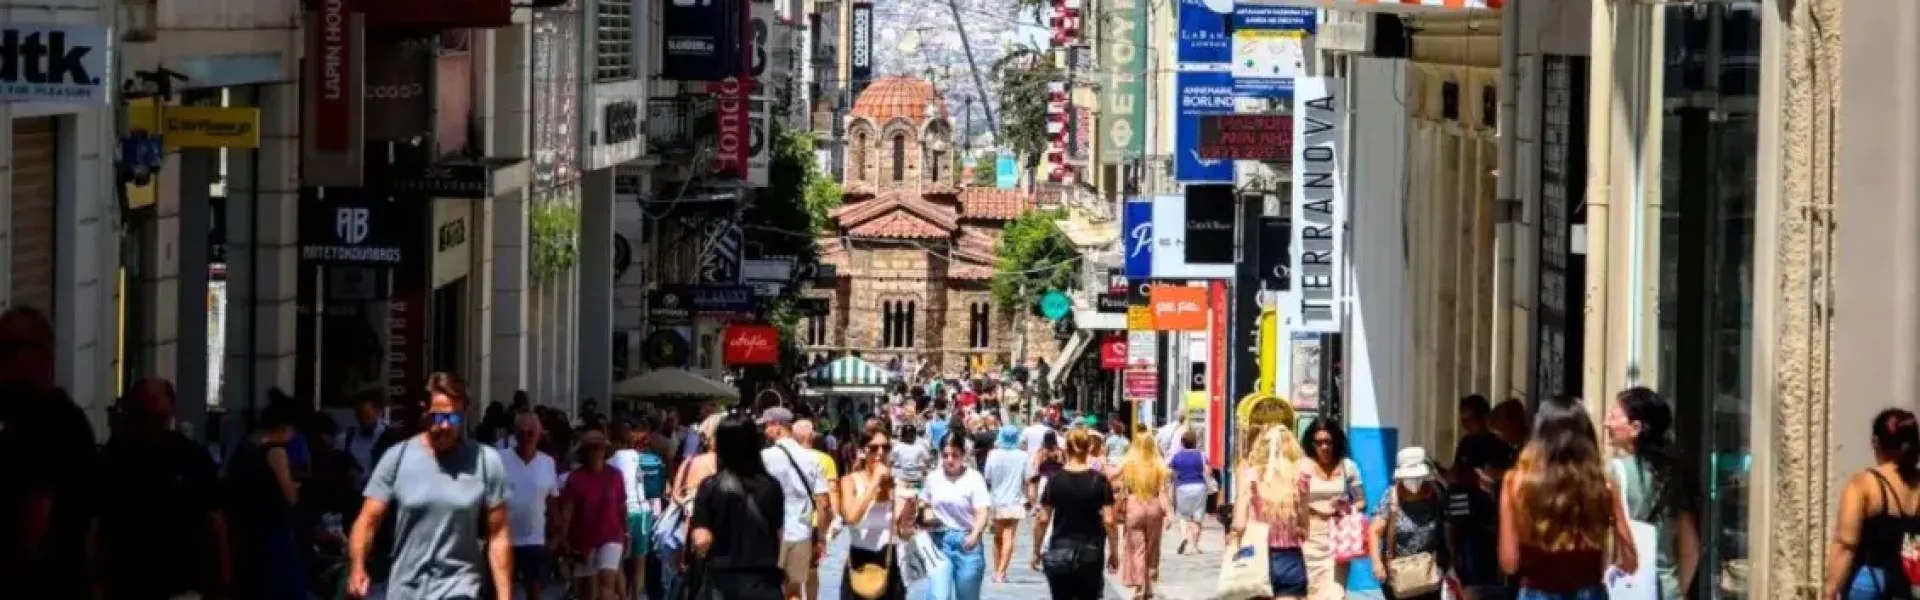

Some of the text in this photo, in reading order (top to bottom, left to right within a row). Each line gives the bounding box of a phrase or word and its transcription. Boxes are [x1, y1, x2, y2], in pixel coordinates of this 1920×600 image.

[854, 8, 865, 67] COSMOS
[323, 45, 341, 100] LAPIN
[1300, 95, 1335, 315] TERRANOVA
